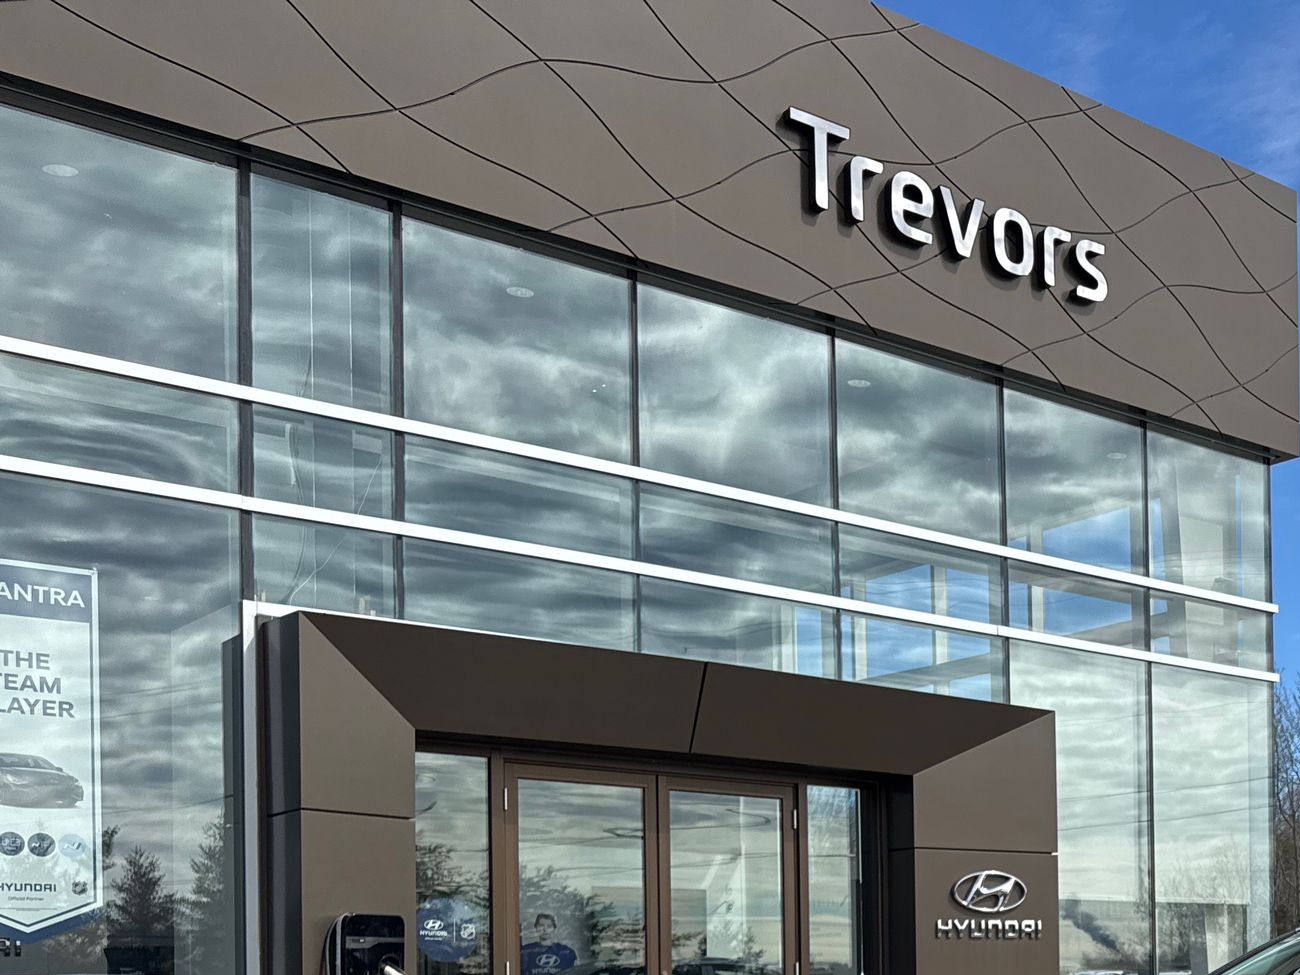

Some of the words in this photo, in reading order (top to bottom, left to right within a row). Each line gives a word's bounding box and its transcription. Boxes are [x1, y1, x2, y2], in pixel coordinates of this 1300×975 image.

[786, 106, 1108, 302] Trevors
[0, 650, 51, 671] THE
[0, 673, 62, 695] EAM
[936, 918, 1042, 939] HYUNDAI
